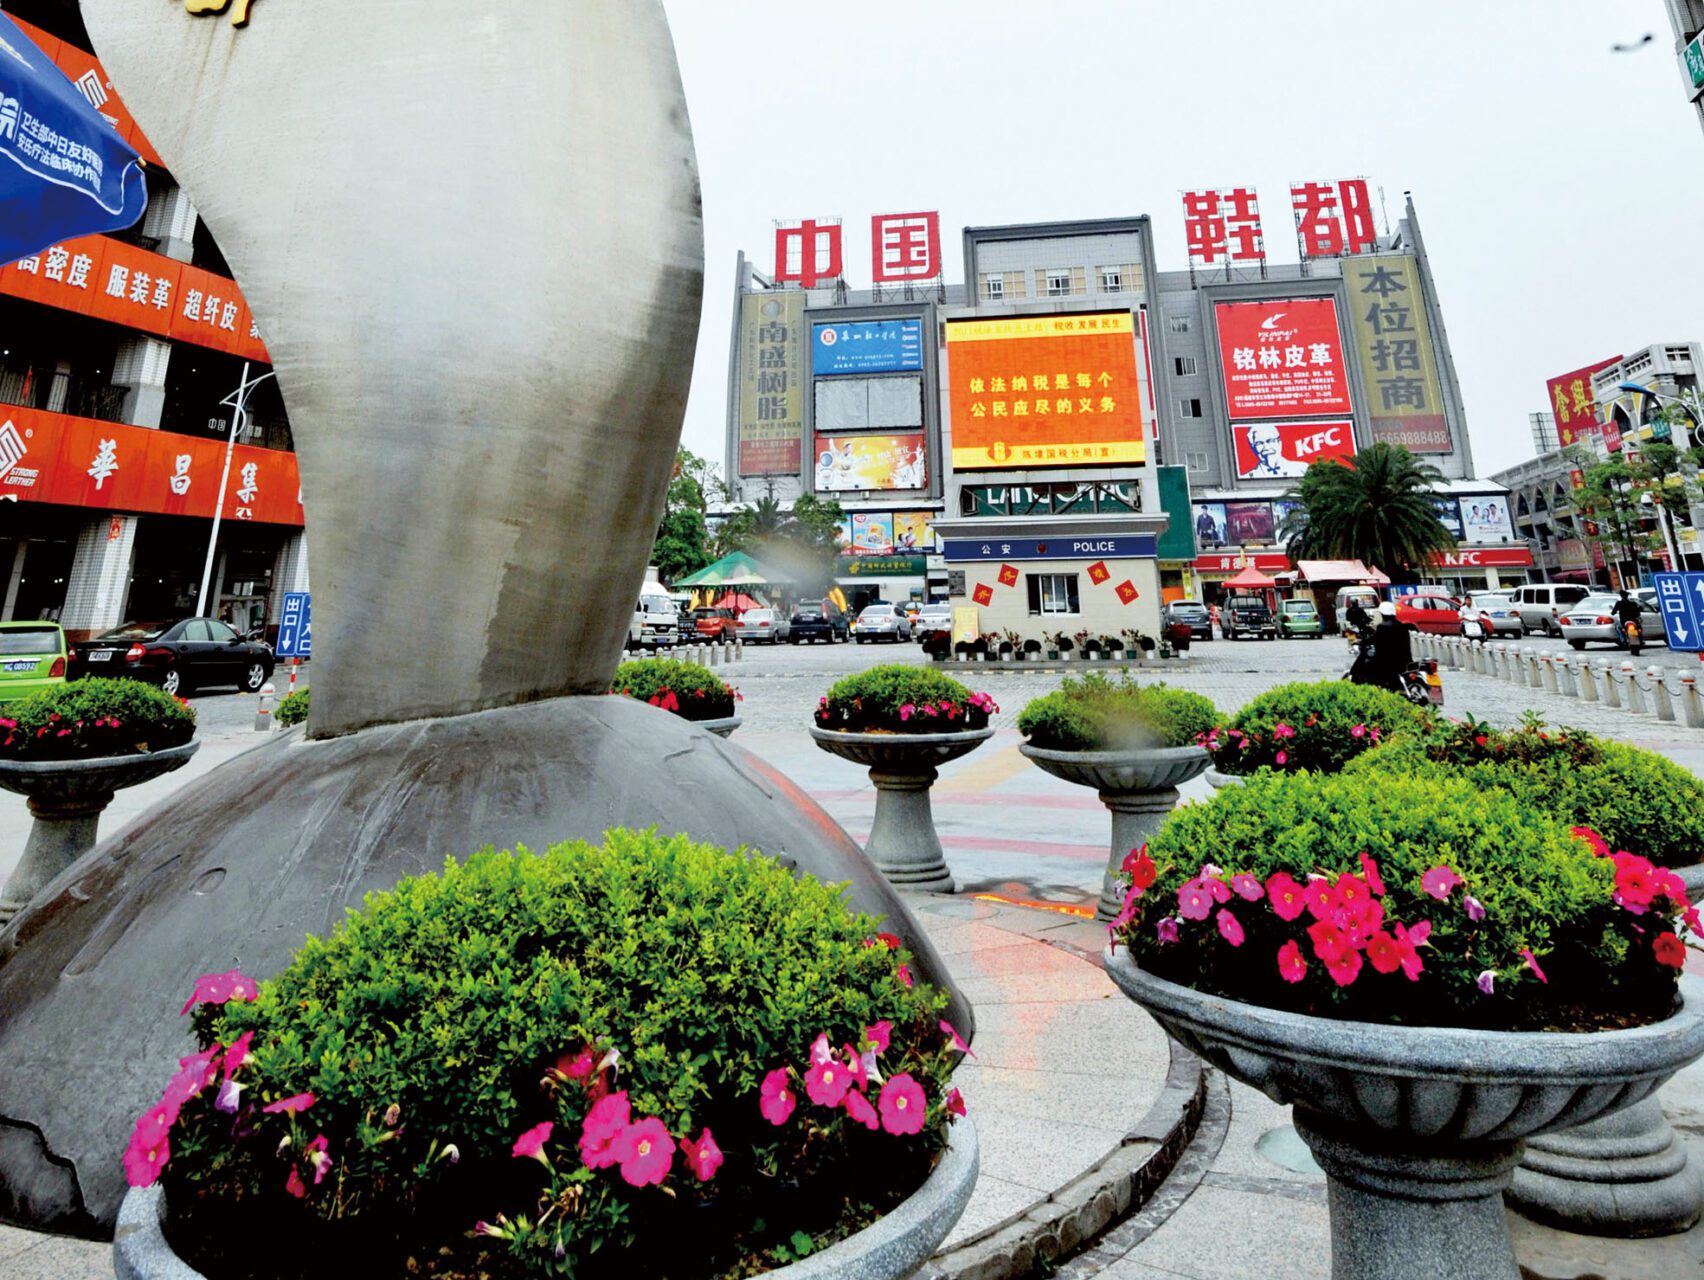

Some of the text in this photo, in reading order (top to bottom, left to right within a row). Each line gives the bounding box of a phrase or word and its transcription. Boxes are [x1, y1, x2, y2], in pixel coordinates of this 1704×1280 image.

[775, 180, 1376, 288] 中国 鞋都
[106, 263, 172, 310] 服装革
[183, 287, 238, 332] 超纤皮
[1359, 266, 1425, 410] 本位招商
[757, 321, 788, 420] 南盛树脂
[1232, 342, 1333, 371] 铭林皮革
[970, 371, 1113, 394] 依法纳税是每个
[970, 396, 1116, 418] 公民应尽的义务
[1295, 427, 1341, 458] KFC
[4, 475, 36, 487] LEATHER
[9, 467, 39, 478] STRONG
[87, 438, 304, 504] 華昌集
[981, 542, 1116, 555] 公安 POLICE
[1444, 552, 1481, 567] KFC
[1660, 578, 1686, 613] 出口
[284, 598, 300, 626] 出口
